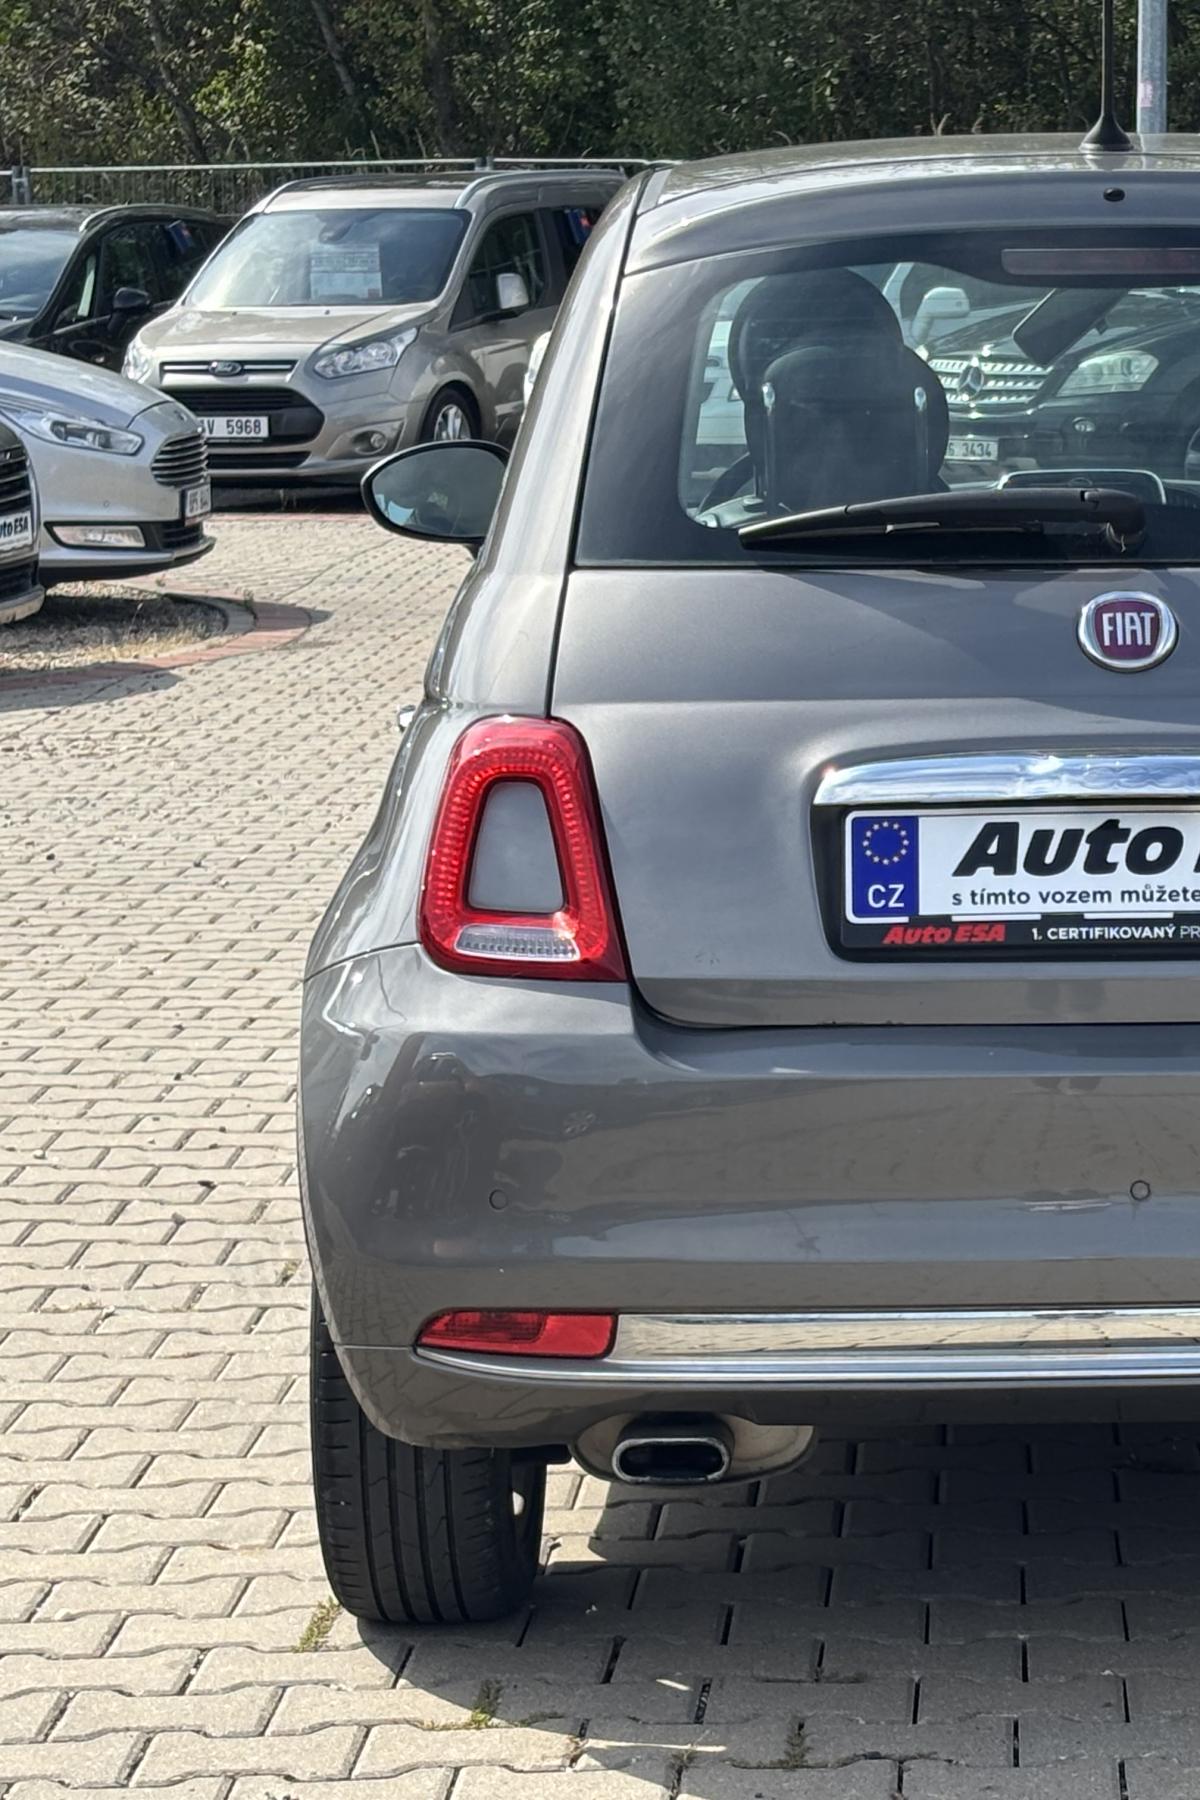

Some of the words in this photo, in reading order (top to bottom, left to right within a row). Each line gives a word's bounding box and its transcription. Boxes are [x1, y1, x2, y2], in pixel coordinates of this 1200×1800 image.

[226, 418, 262, 435] 5968
[961, 442, 993, 458] 3434
[1102, 612, 1155, 646] FIAT
[951, 819, 1184, 877] Auto
[867, 884, 905, 908] CZ
[952, 893, 963, 906] s
[970, 887, 1031, 905] tímto
[1038, 890, 1112, 904] vozem
[882, 924, 953, 944] Auto
[954, 924, 1006, 943] ESA
[1032, 928, 1042, 941] 1.
[1047, 923, 1176, 940] CERTIFIKOVANÝ
